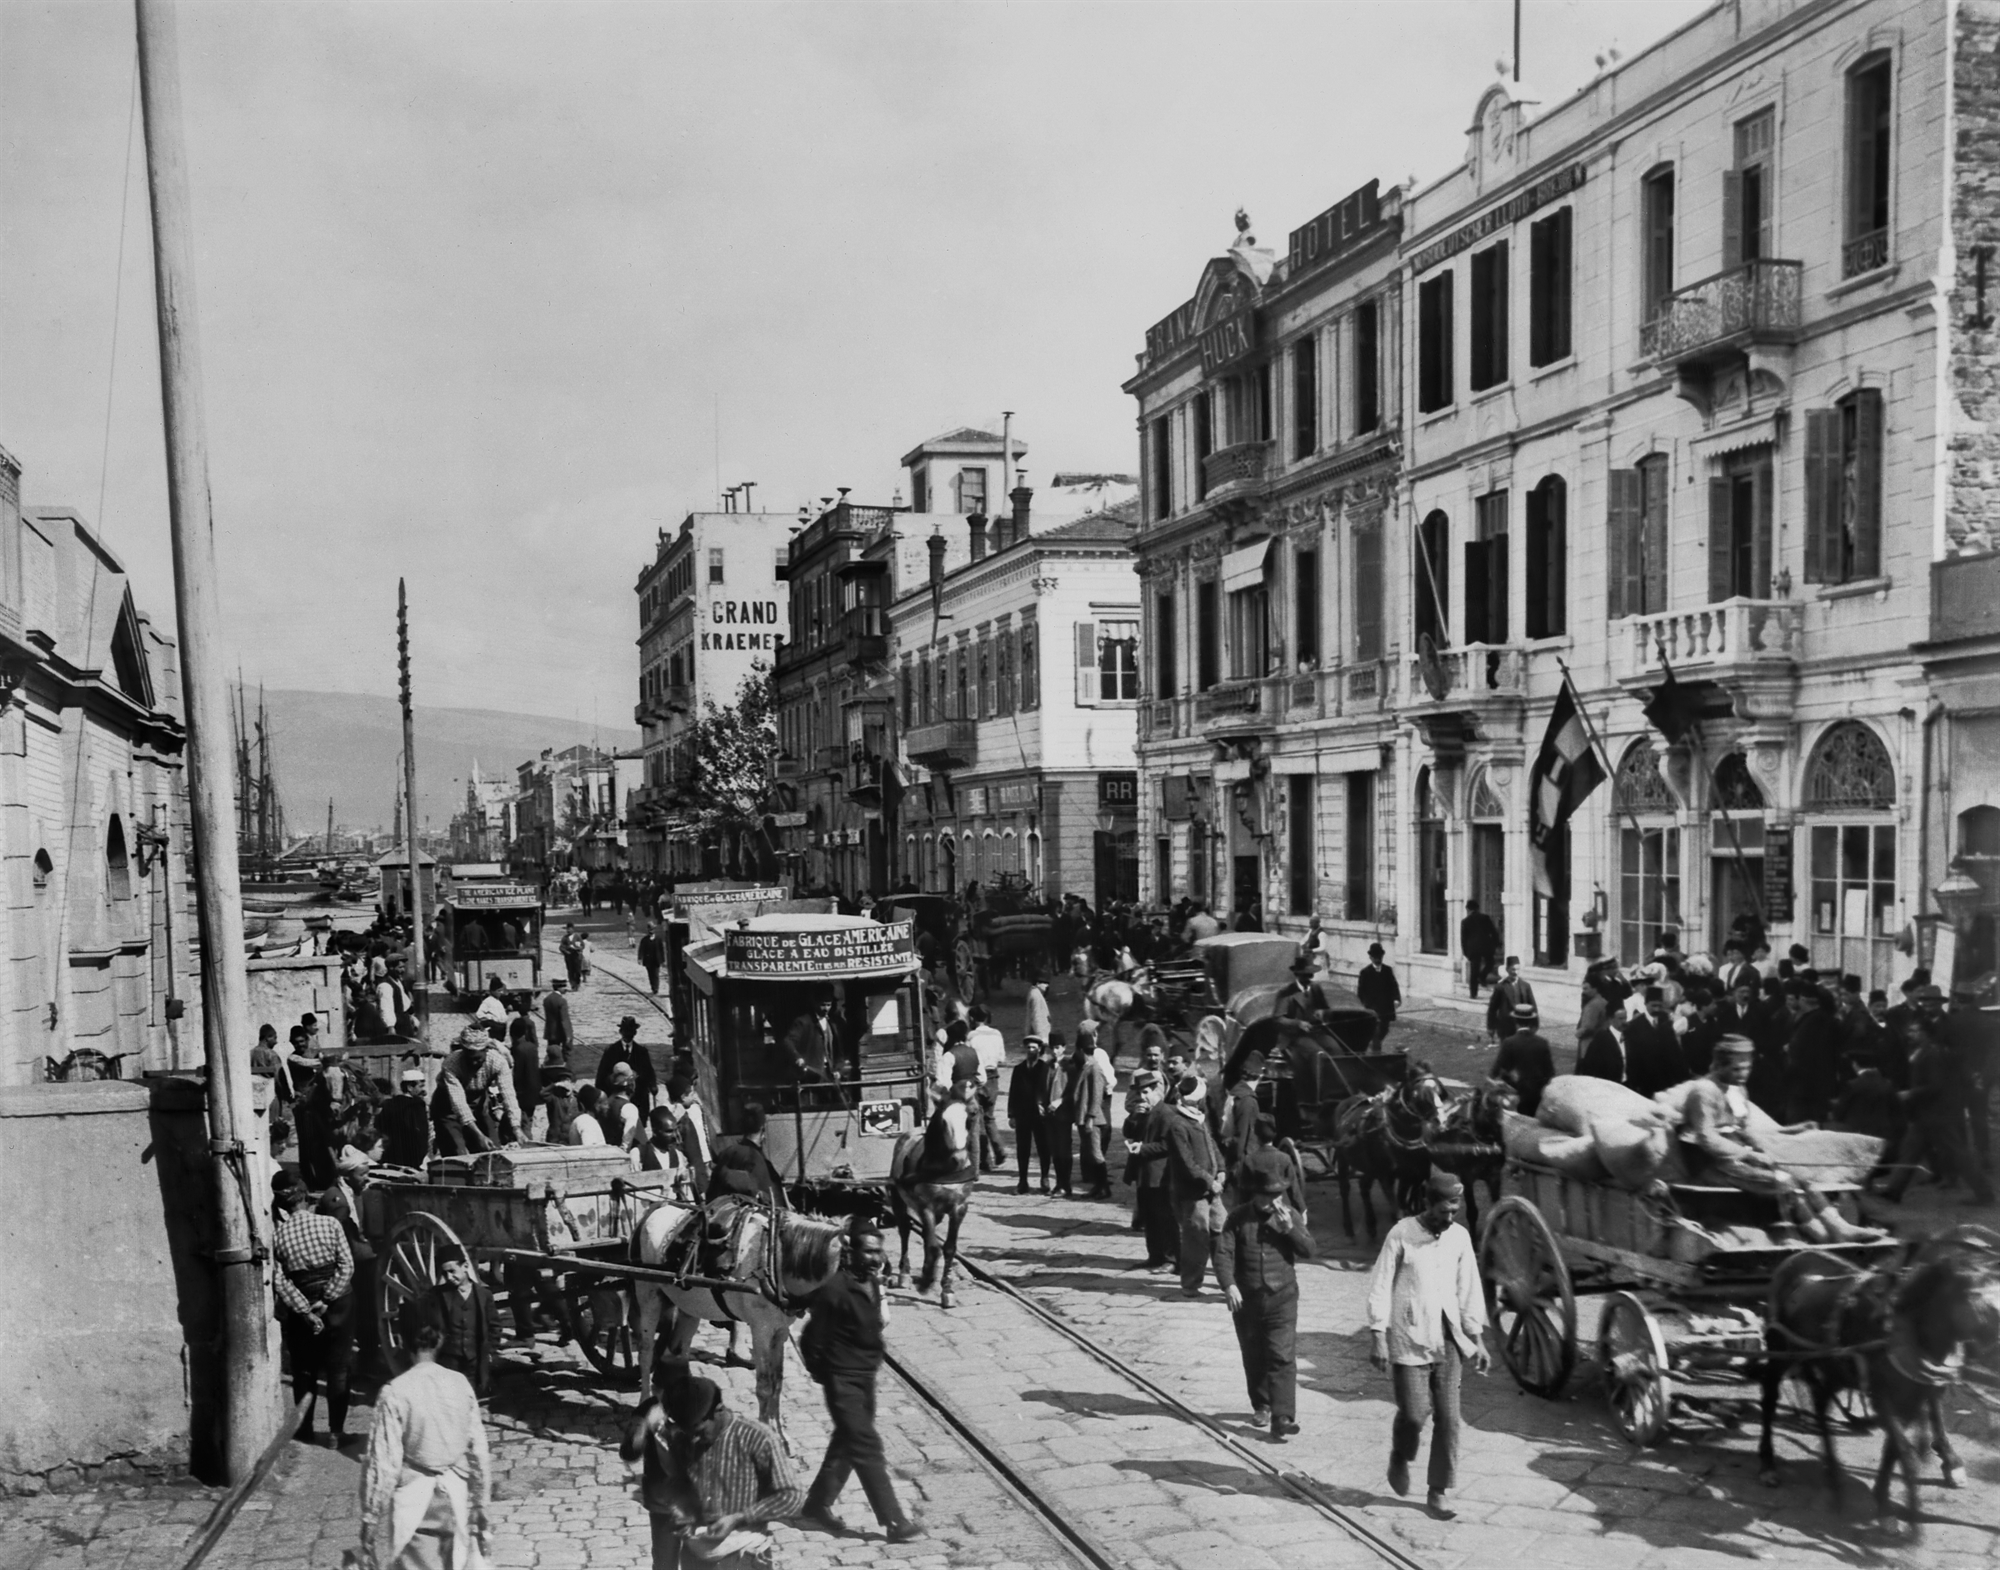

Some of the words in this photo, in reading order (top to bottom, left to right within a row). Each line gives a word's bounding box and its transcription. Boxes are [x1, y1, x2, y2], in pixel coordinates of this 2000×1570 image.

[1290, 191, 1370, 272] HOTEL
[1201, 317, 1249, 372] HUCK
[713, 601, 777, 624] GRAND
[701, 633, 774, 651] KRAEME
[473, 888, 504, 896] AMERICAN
[505, 887, 515, 895] ICE
[517, 886, 535, 895] PLANT
[674, 894, 709, 904] FABRIQUE
[715, 892, 741, 902] GLACE
[727, 932, 779, 950] FABRIQUE
[782, 939, 796, 948] DE
[798, 933, 841, 948] GLACE
[727, 960, 814, 972] TRANSPARENTE
[847, 951, 912, 969] RESISTANTE
[747, 949, 784, 959] GLACE
[803, 948, 829, 958] EAU
